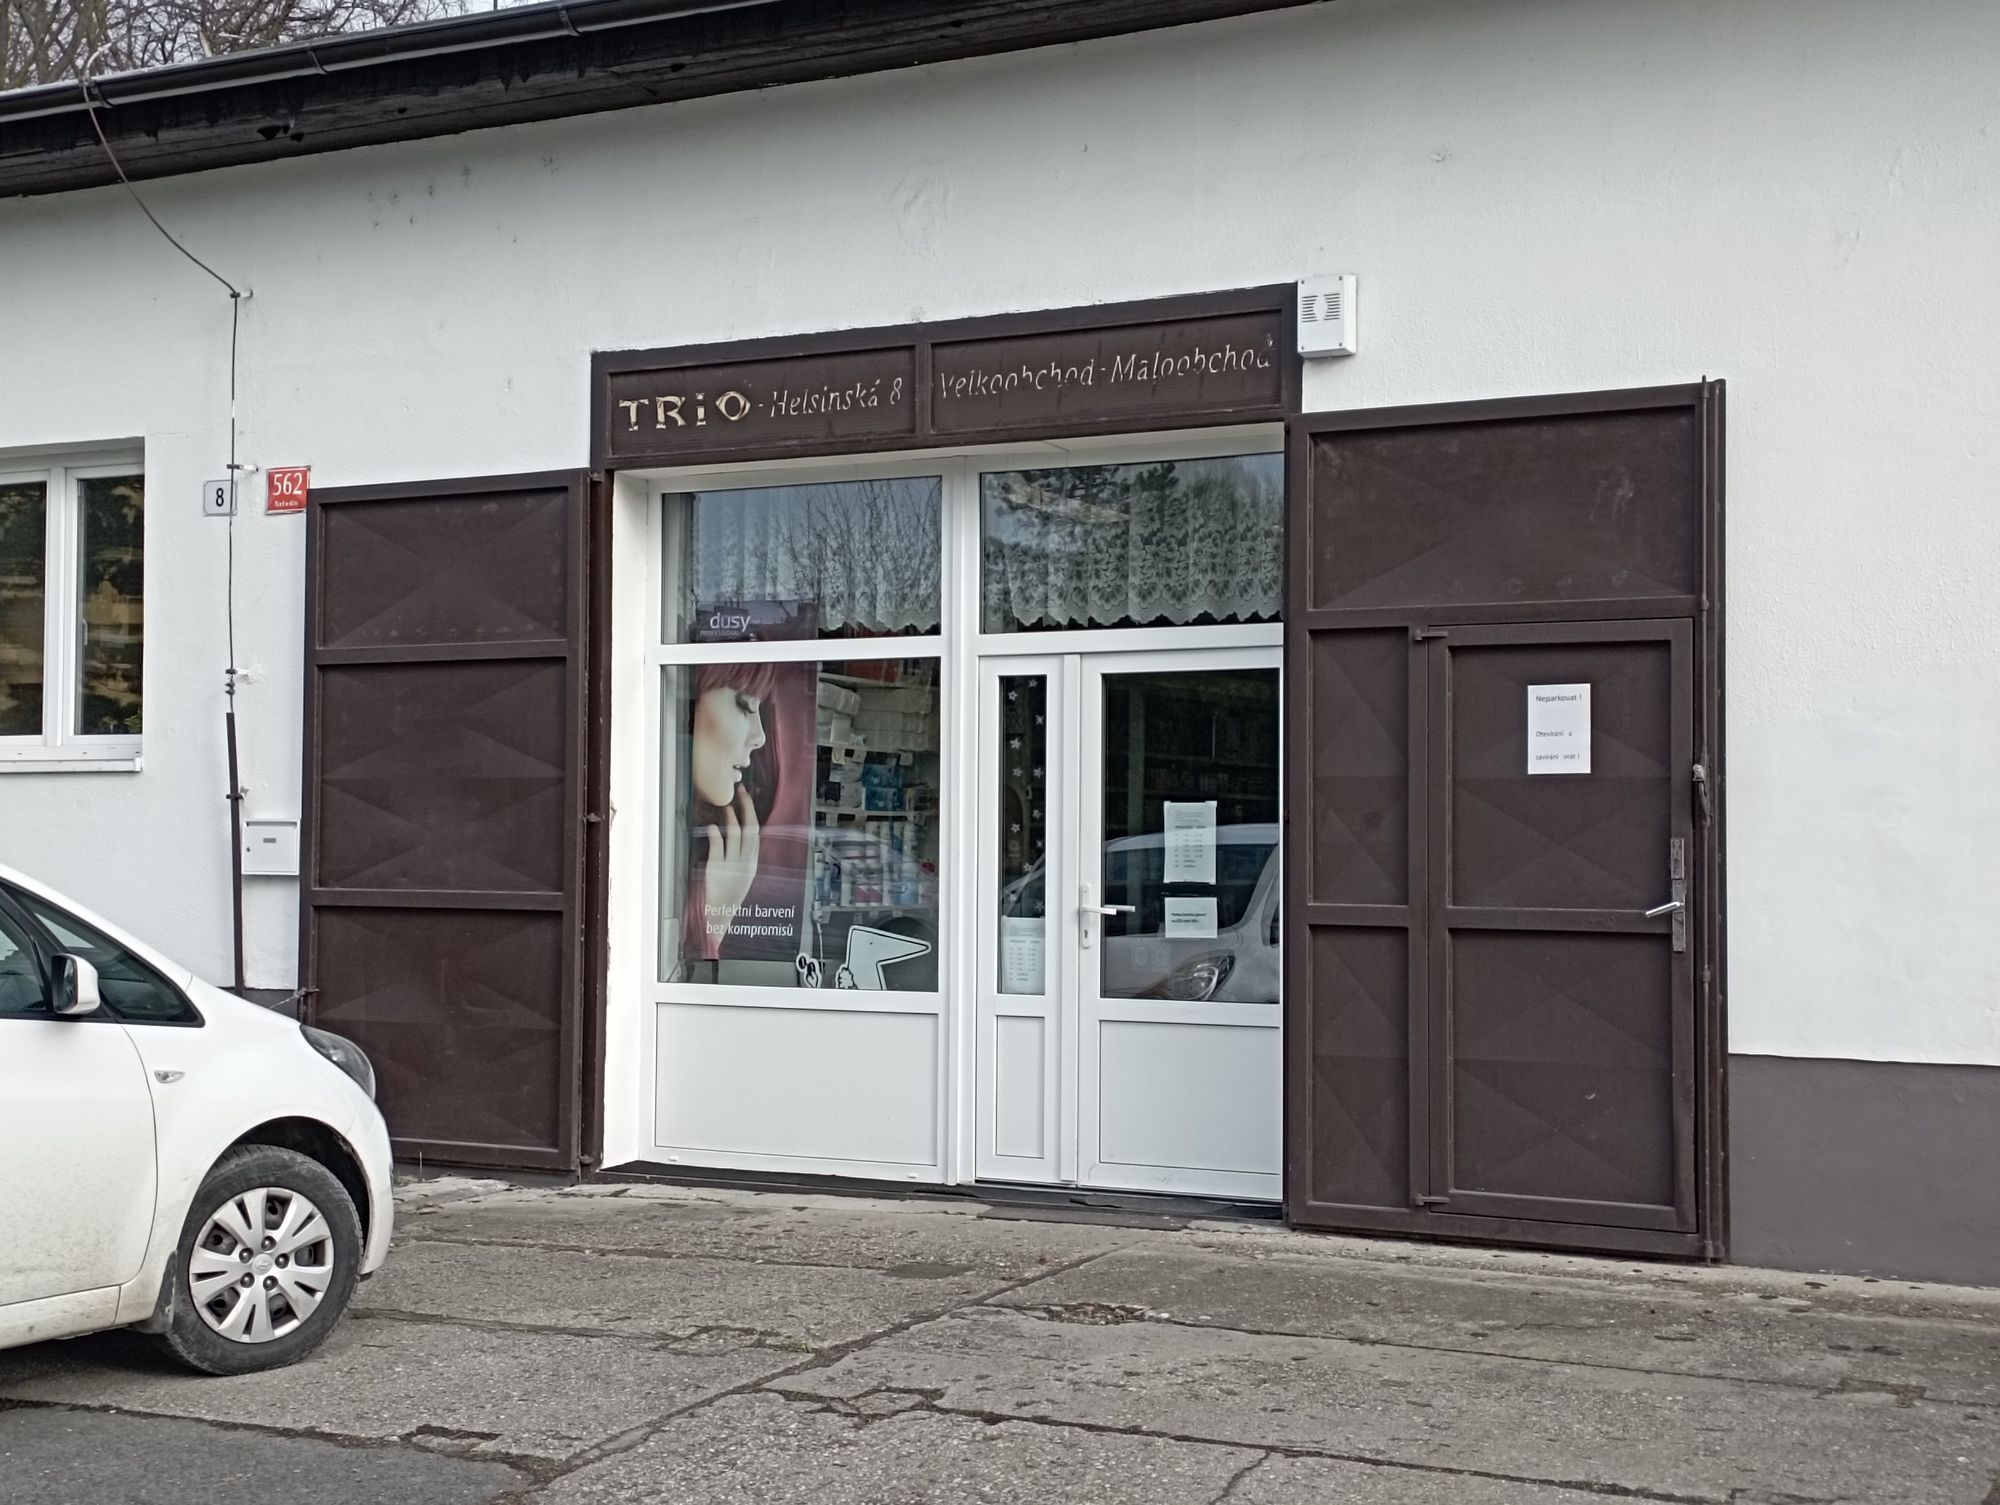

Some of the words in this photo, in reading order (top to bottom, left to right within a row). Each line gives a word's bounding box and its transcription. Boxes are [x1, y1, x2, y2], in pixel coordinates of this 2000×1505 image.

[770, 378, 881, 418] Helsinská
[889, 377, 903, 405] 8
[273, 472, 303, 495] 562
[215, 487, 224, 507] 8
[709, 612, 751, 632] dusy
[704, 904, 752, 918] Perfektní
[754, 904, 795, 919] barvení
[706, 922, 726, 935] bez
[727, 923, 794, 939] kompromisů
